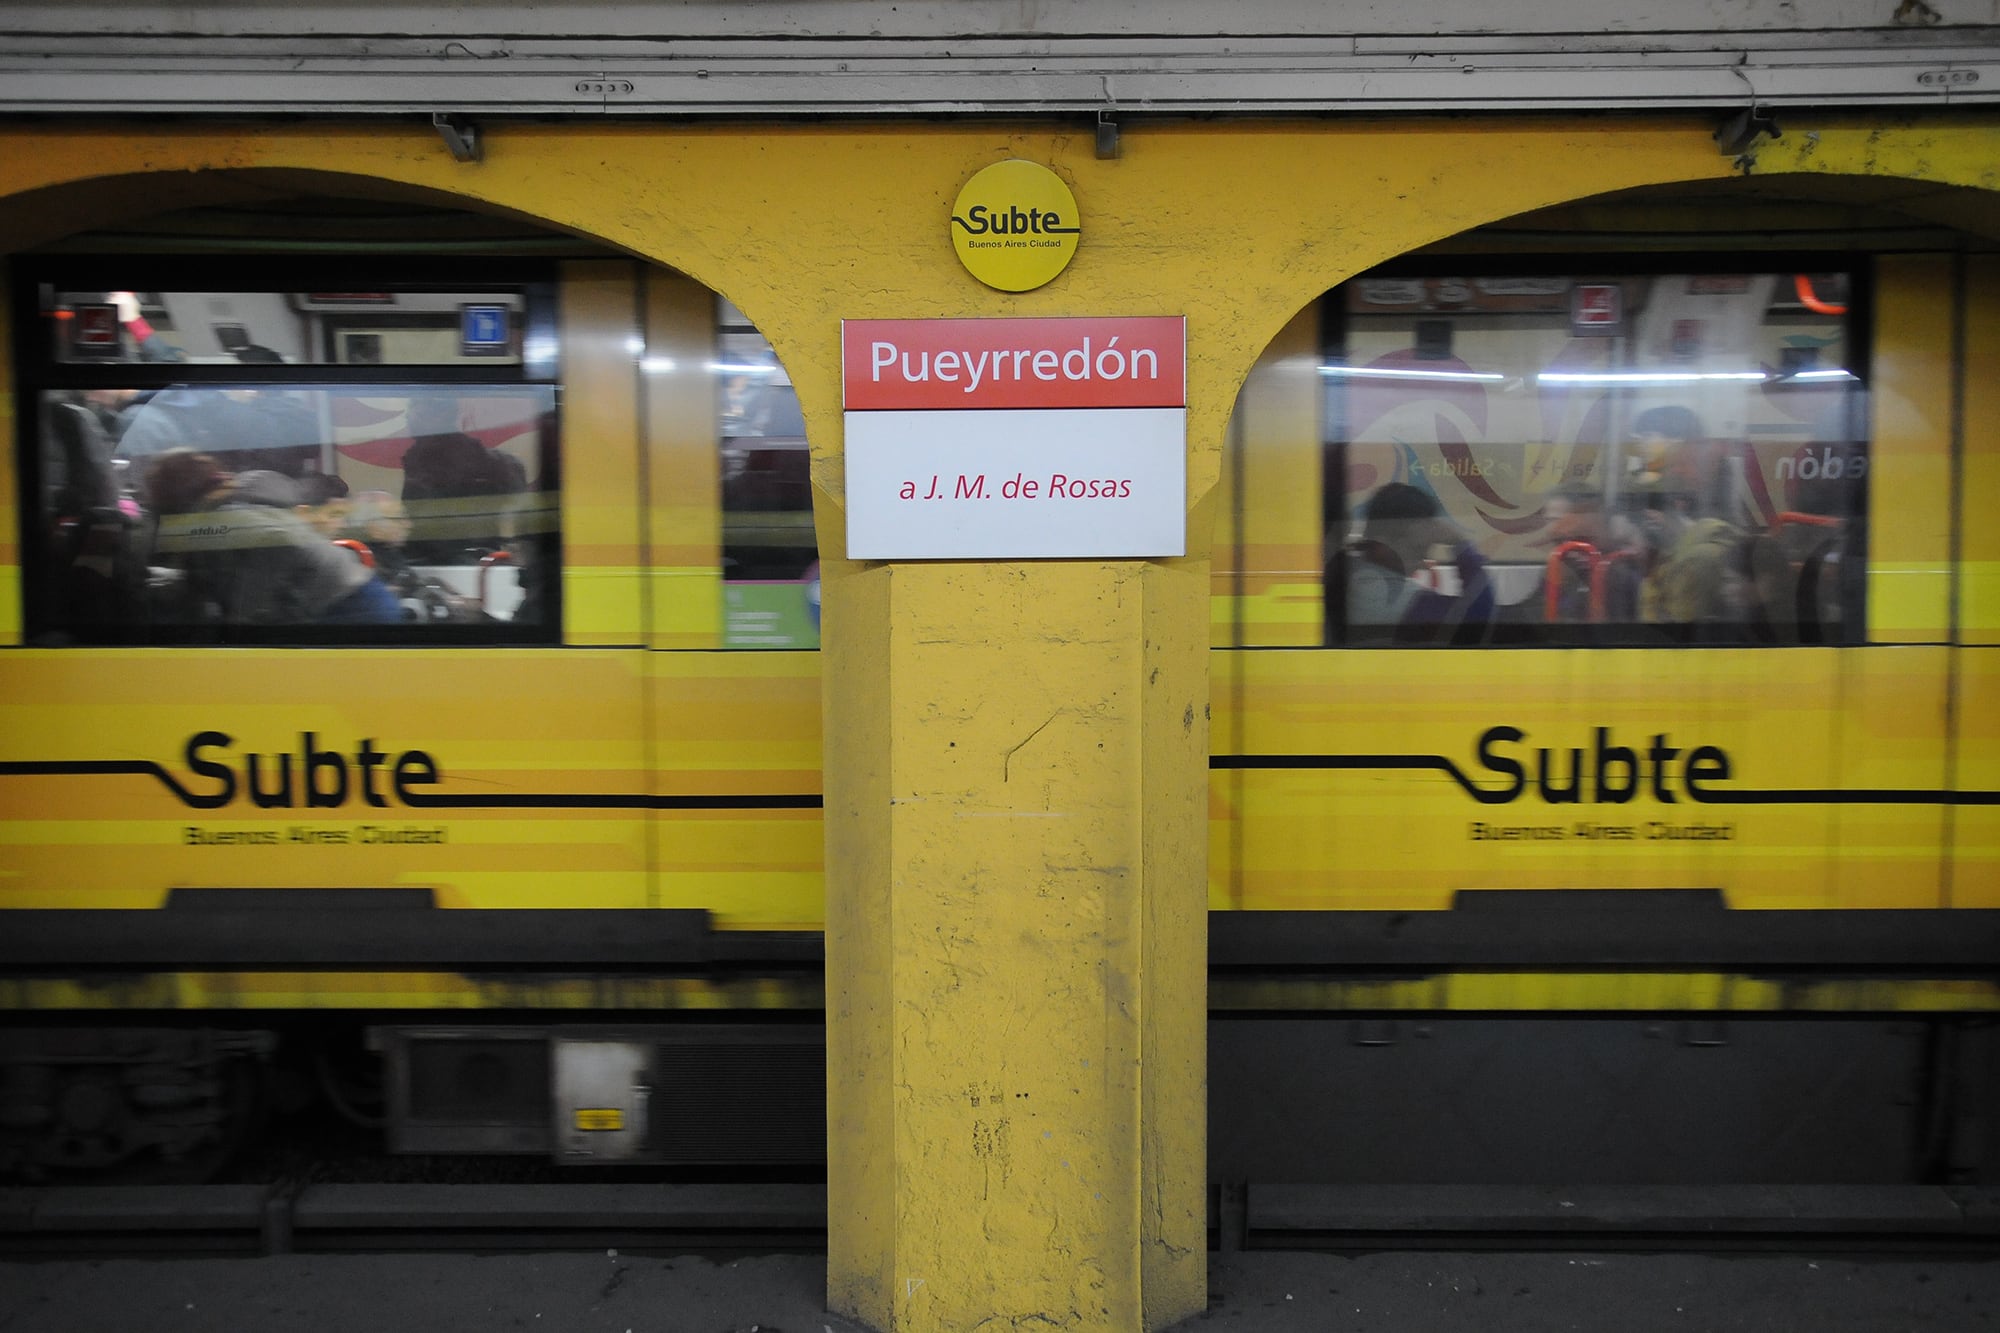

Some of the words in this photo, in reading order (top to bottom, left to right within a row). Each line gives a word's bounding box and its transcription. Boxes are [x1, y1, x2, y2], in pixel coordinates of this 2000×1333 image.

[967, 205, 1061, 234] Subte
[968, 240, 1002, 249] Buenos
[1004, 240, 1027, 248] Aires
[1029, 239, 1061, 248] Ciudad
[871, 336, 1158, 393] Pueyrredón
[899, 481, 915, 500] a
[924, 475, 943, 500] J.
[954, 475, 991, 499] M.
[1002, 473, 1039, 499] de
[1049, 473, 1132, 499] Rosas
[184, 731, 441, 809] Subte
[1475, 725, 1732, 804] Subte
